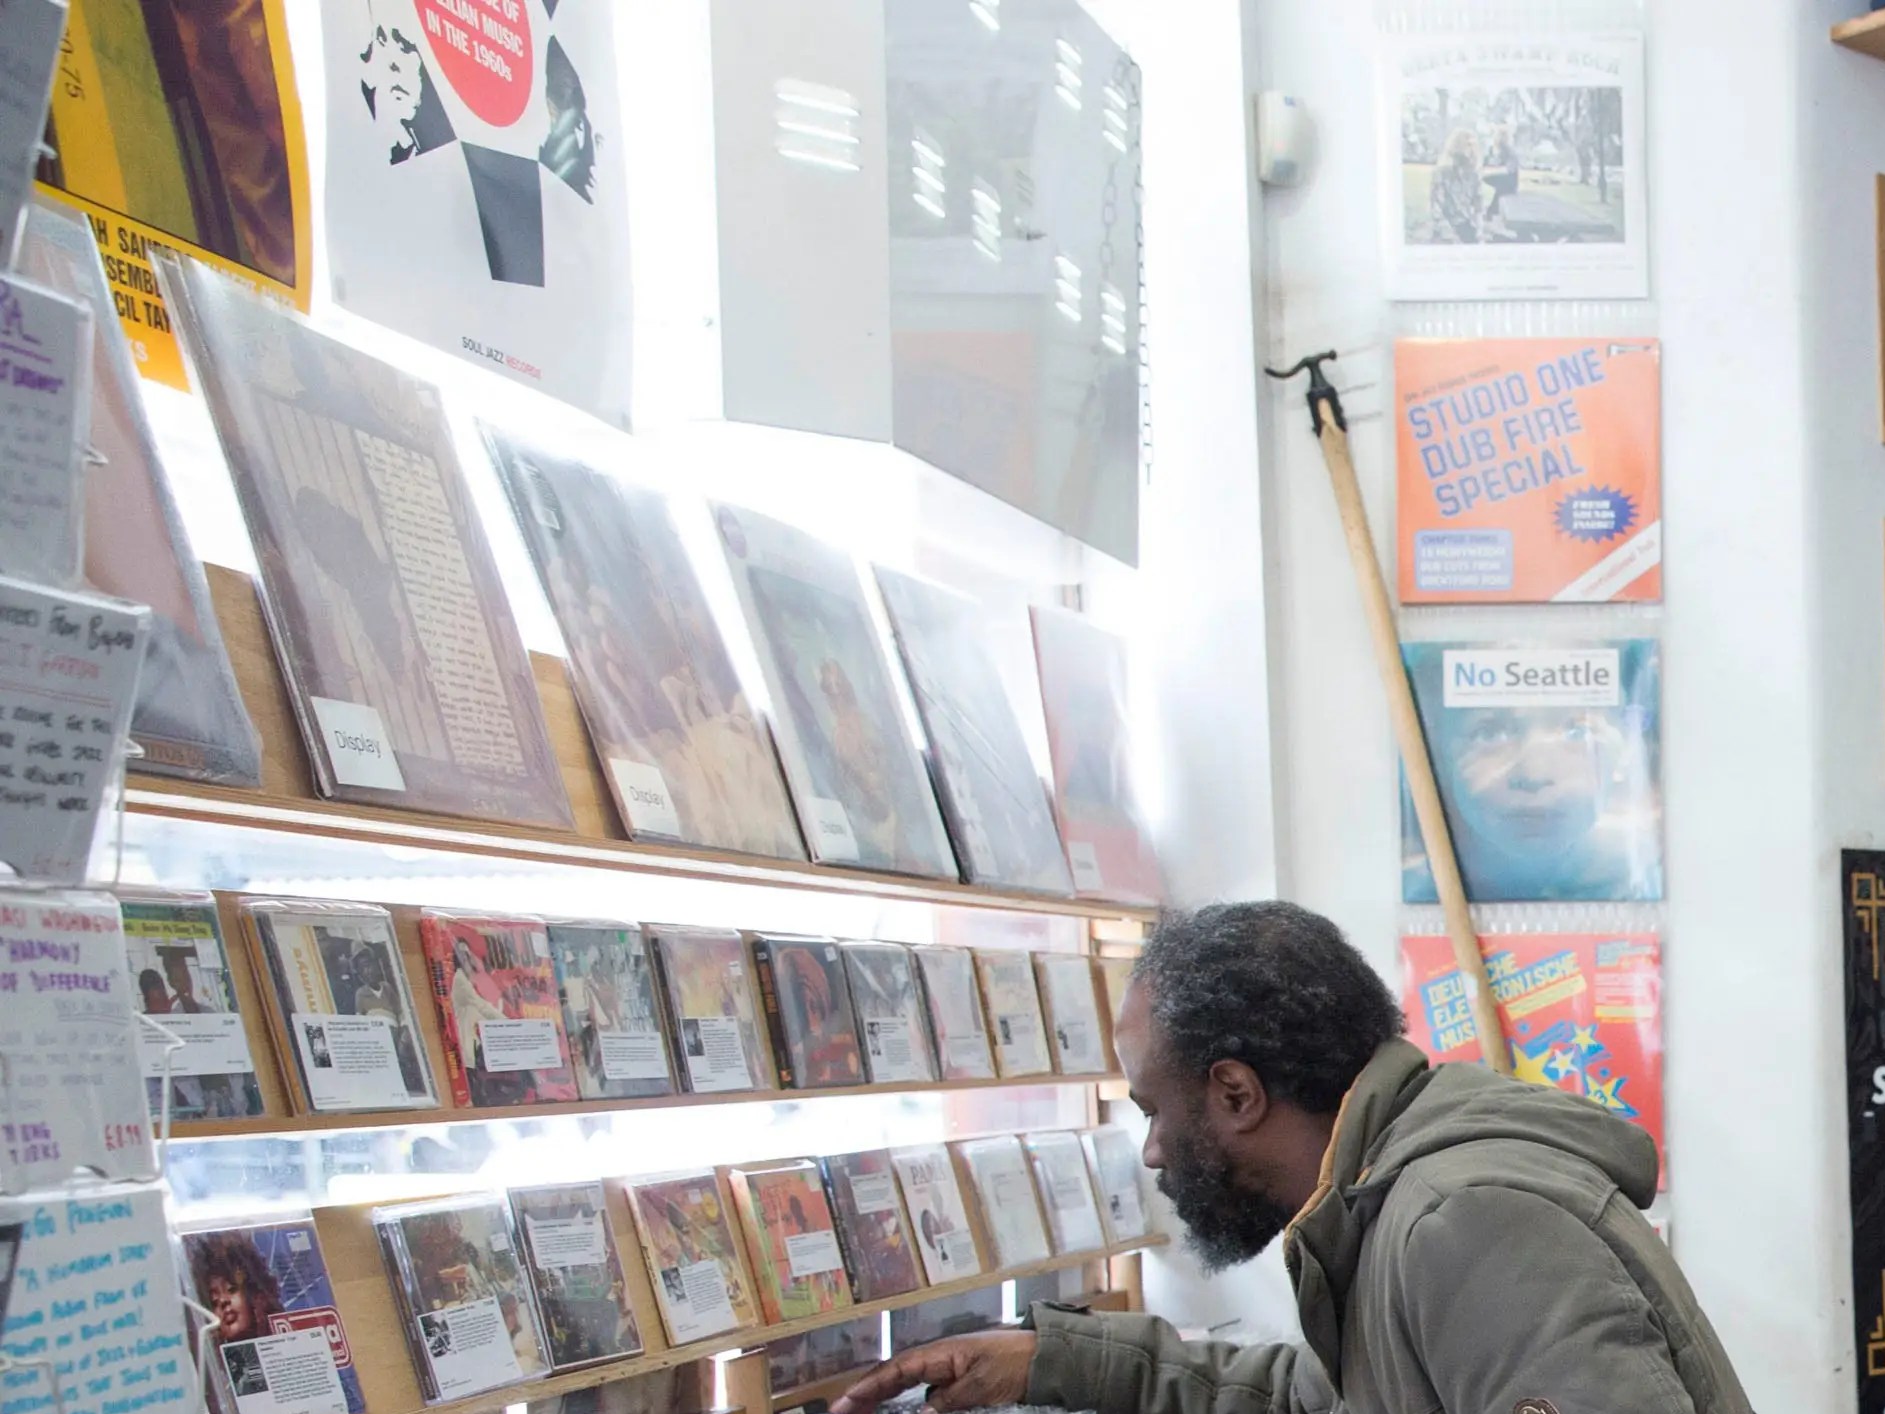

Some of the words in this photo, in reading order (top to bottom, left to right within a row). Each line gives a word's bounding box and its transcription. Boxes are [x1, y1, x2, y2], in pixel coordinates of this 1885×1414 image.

[425, 7, 441, 32] IN
[442, 22, 470, 53] THE
[482, 13, 525, 59] MUSIC
[1408, 371, 1530, 441] STUDIO
[1535, 347, 1607, 398] ONE
[1420, 426, 1497, 481] DUB
[1502, 398, 1584, 452] FIRE
[1433, 444, 1586, 520] SPECIAL
[1454, 661, 1496, 688] No
[1504, 659, 1611, 688] Seattle
[333, 728, 382, 761] Display
